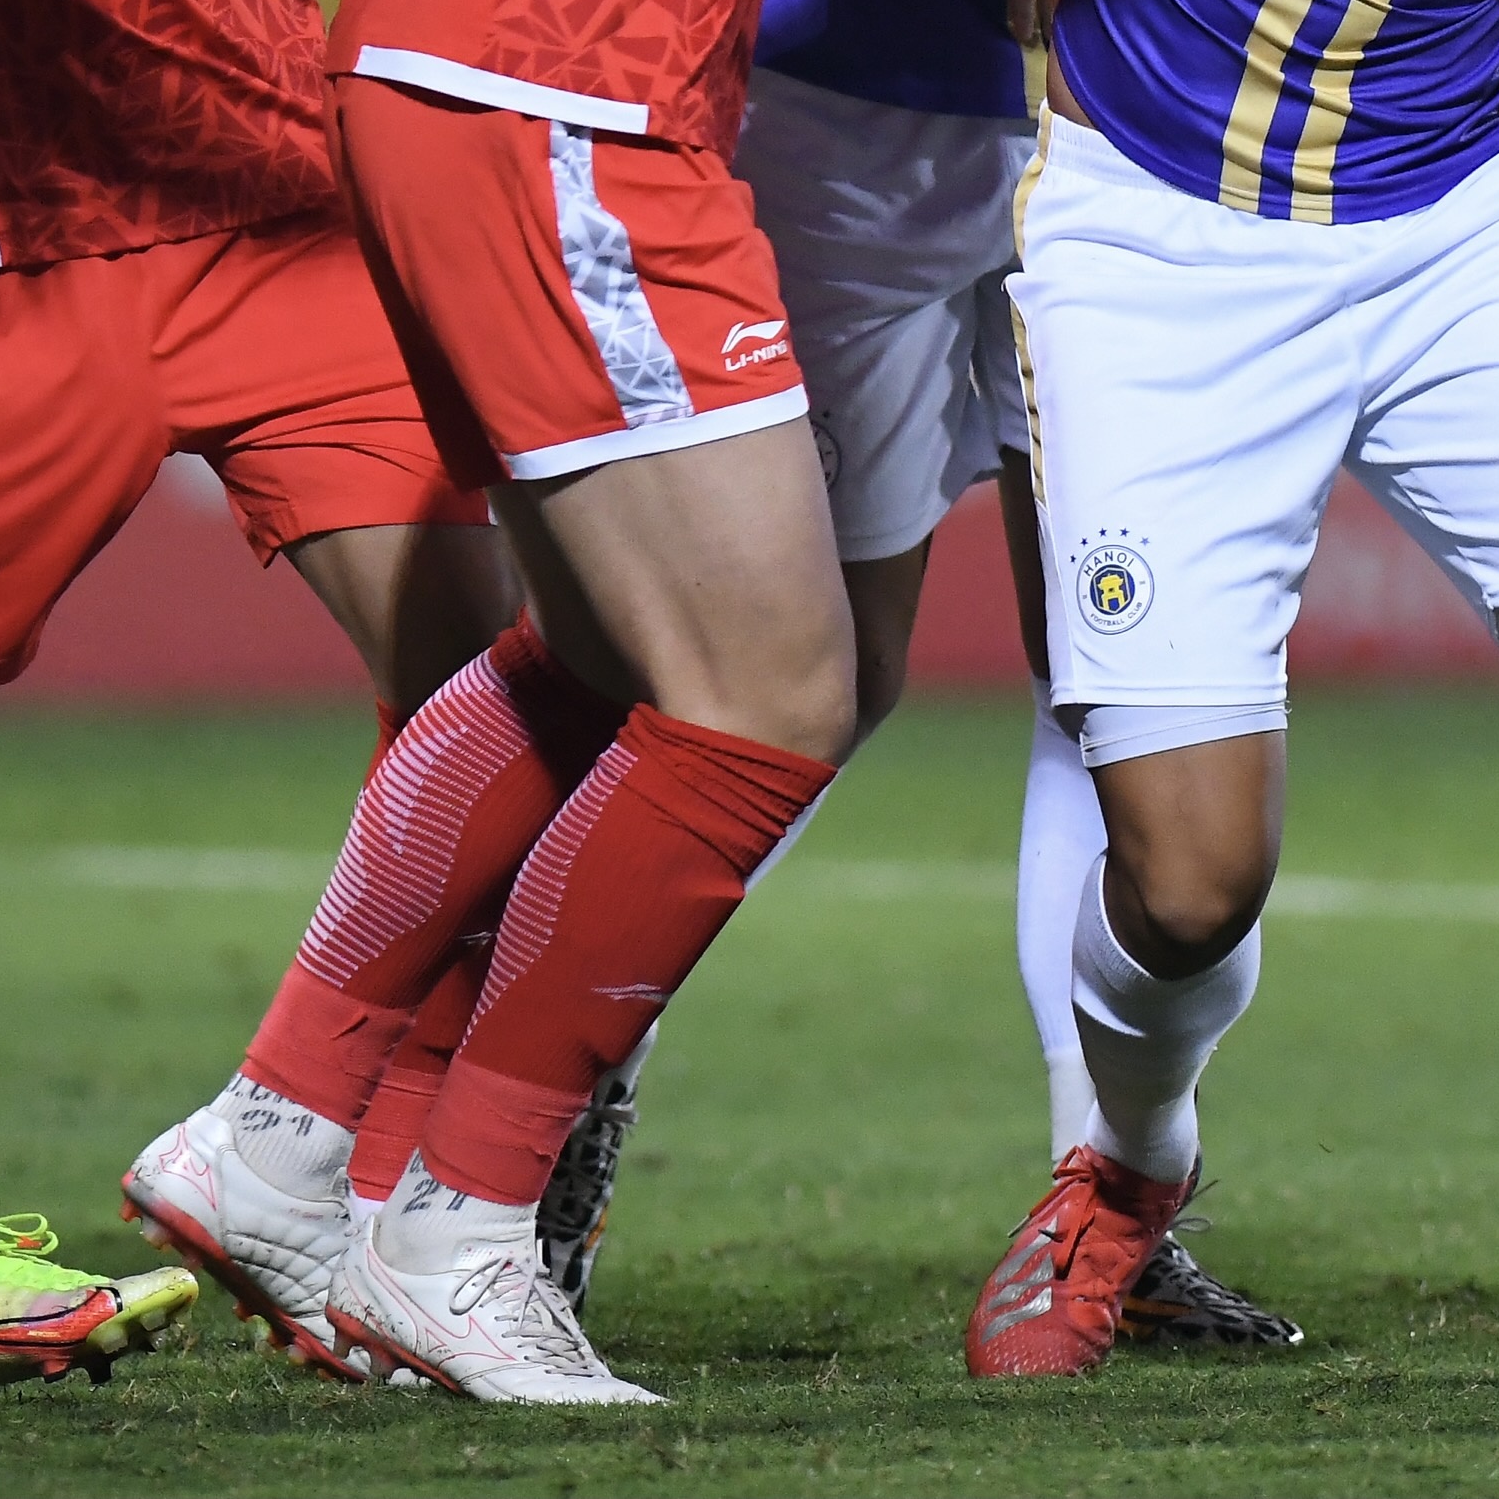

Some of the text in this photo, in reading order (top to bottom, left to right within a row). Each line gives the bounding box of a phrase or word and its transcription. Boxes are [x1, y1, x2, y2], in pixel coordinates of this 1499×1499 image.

[724, 339, 789, 372] LI-NING
[1083, 550, 1135, 577] HANOI
[1089, 612, 1126, 627] FOOTBALL
